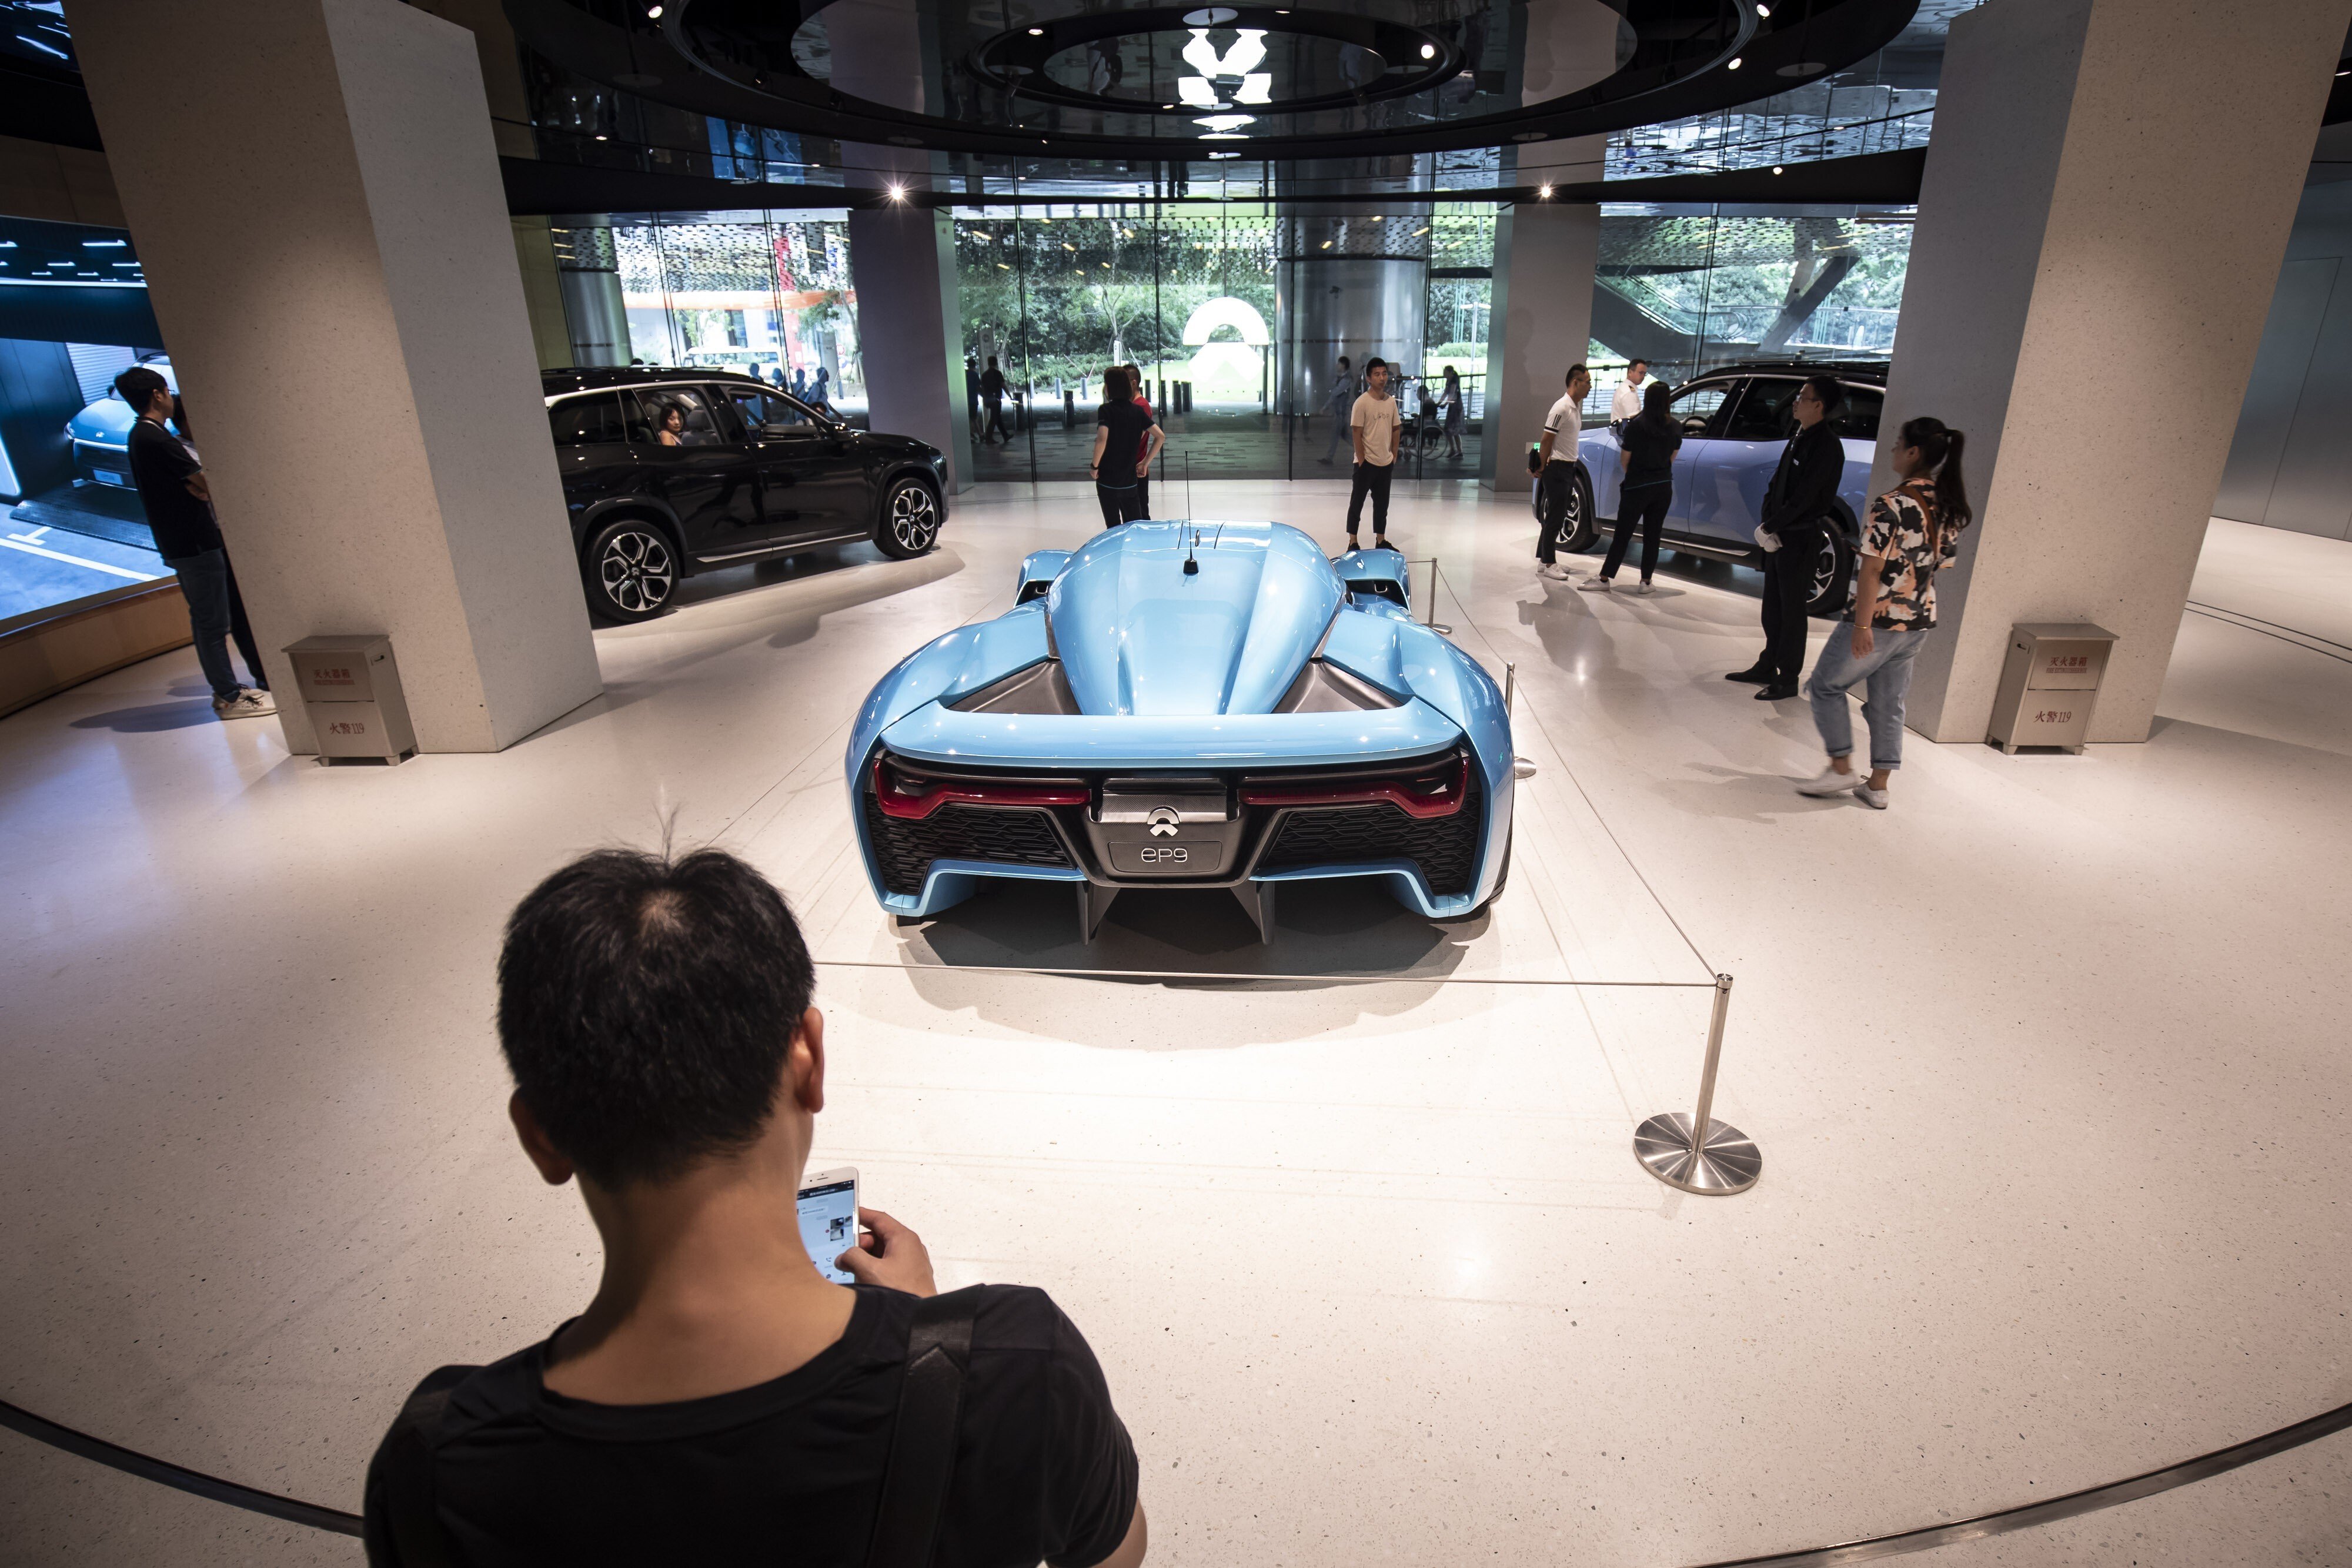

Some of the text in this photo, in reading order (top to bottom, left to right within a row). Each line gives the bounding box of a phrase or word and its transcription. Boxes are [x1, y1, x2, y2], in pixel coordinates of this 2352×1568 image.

[2049, 656, 2088, 667] 灭火器箱
[2034, 711, 2072, 723] 火警119
[330, 723, 364, 734] 火警119
